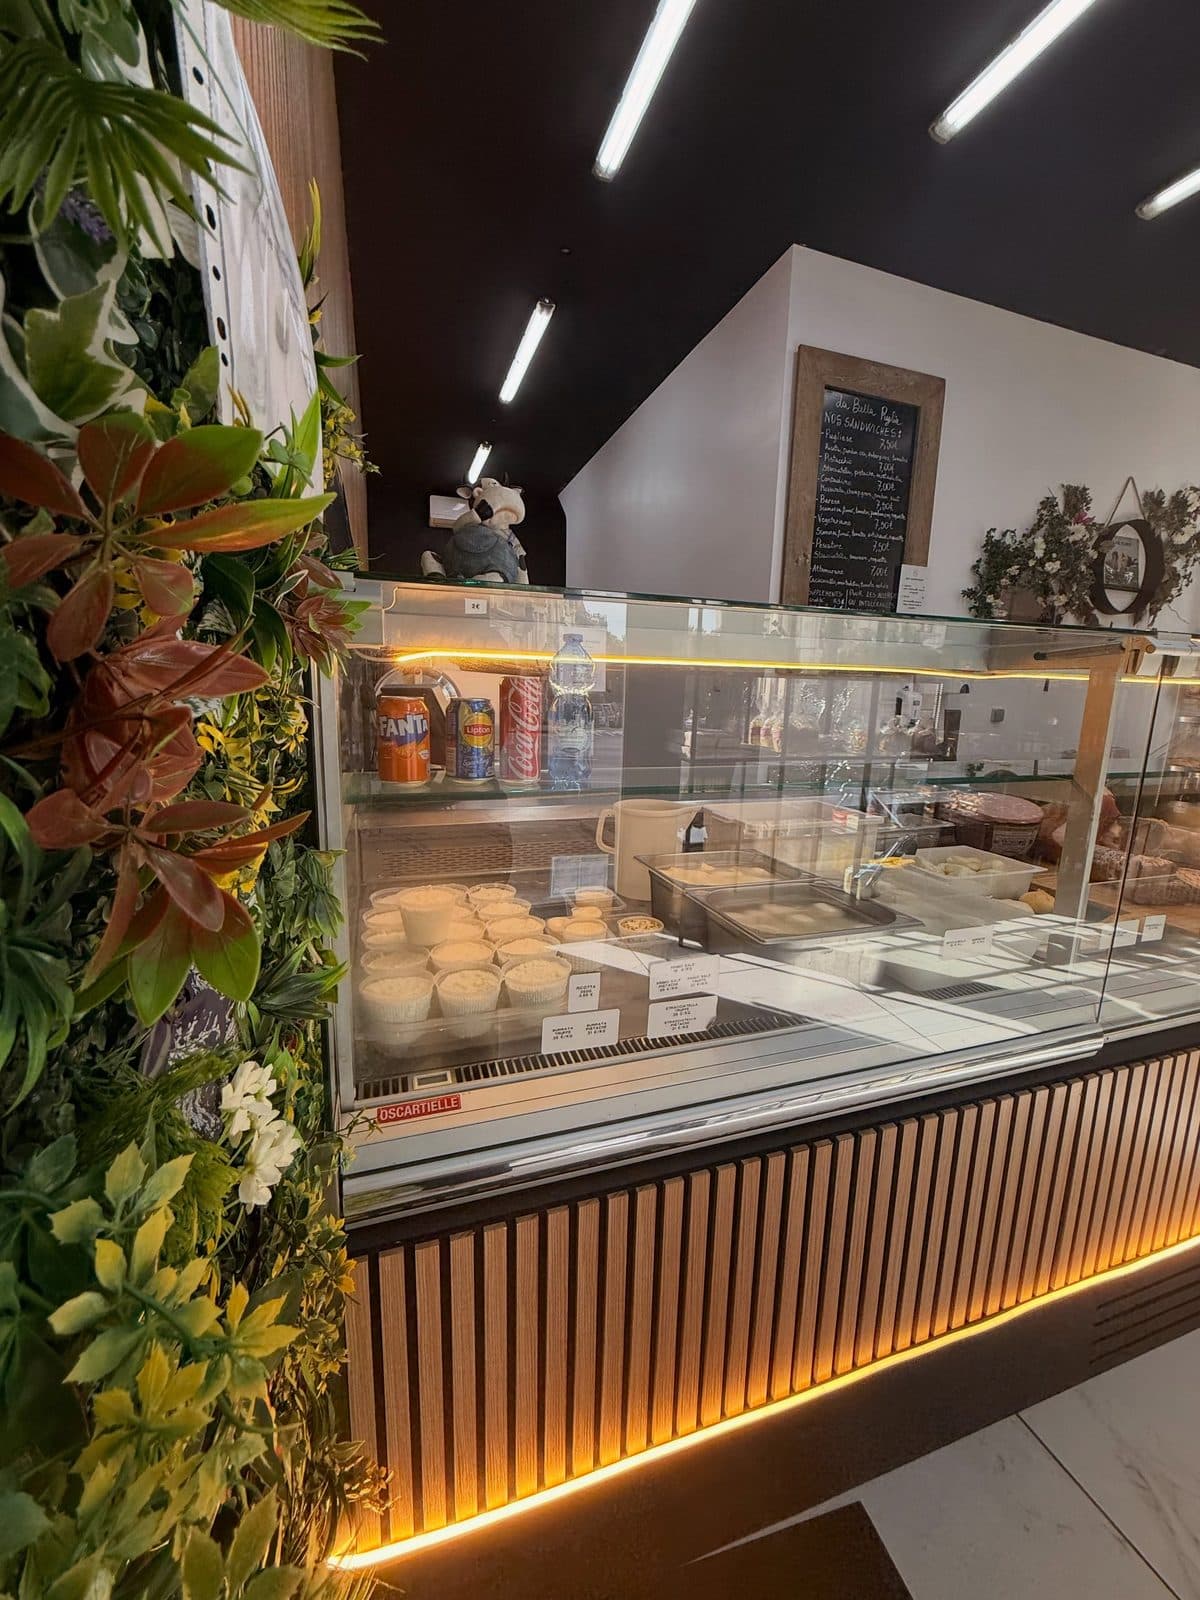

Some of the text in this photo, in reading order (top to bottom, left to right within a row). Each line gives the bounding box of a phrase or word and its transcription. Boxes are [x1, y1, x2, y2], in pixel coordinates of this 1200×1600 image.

[824, 411, 842, 427] NOS
[466, 725, 491, 736] Lipton
[380, 1097, 458, 1121] OSCARTIELLE
